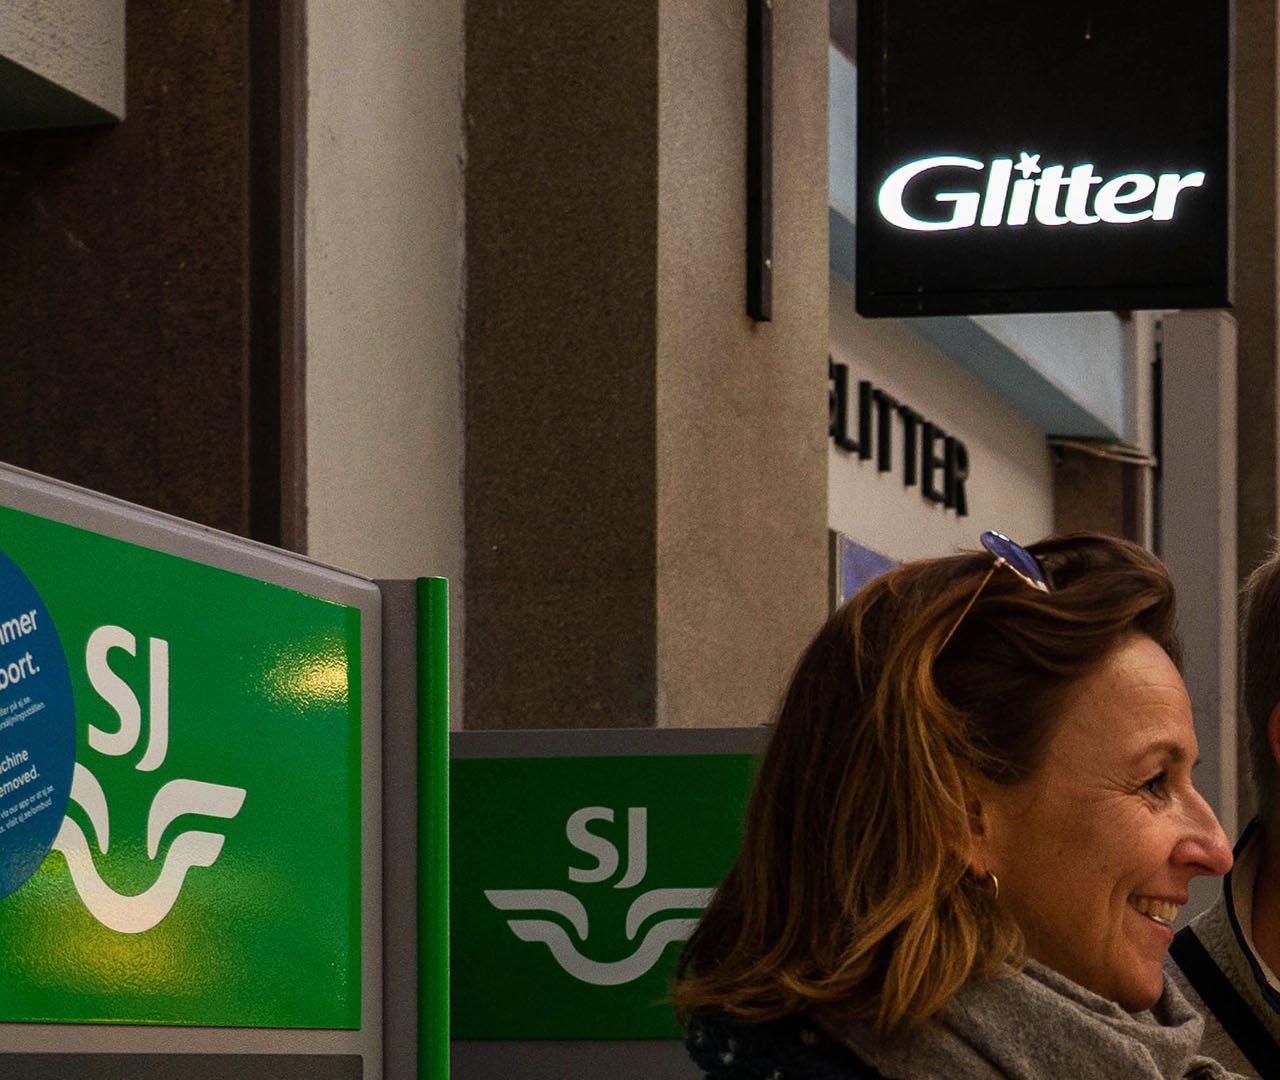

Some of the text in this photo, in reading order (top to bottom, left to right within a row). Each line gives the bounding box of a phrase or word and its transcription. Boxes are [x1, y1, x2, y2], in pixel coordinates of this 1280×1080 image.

[878, 151, 1206, 232] Glitter
[86, 625, 169, 772] SJ
[0, 749, 29, 776] chine
[566, 806, 648, 889] SJ
